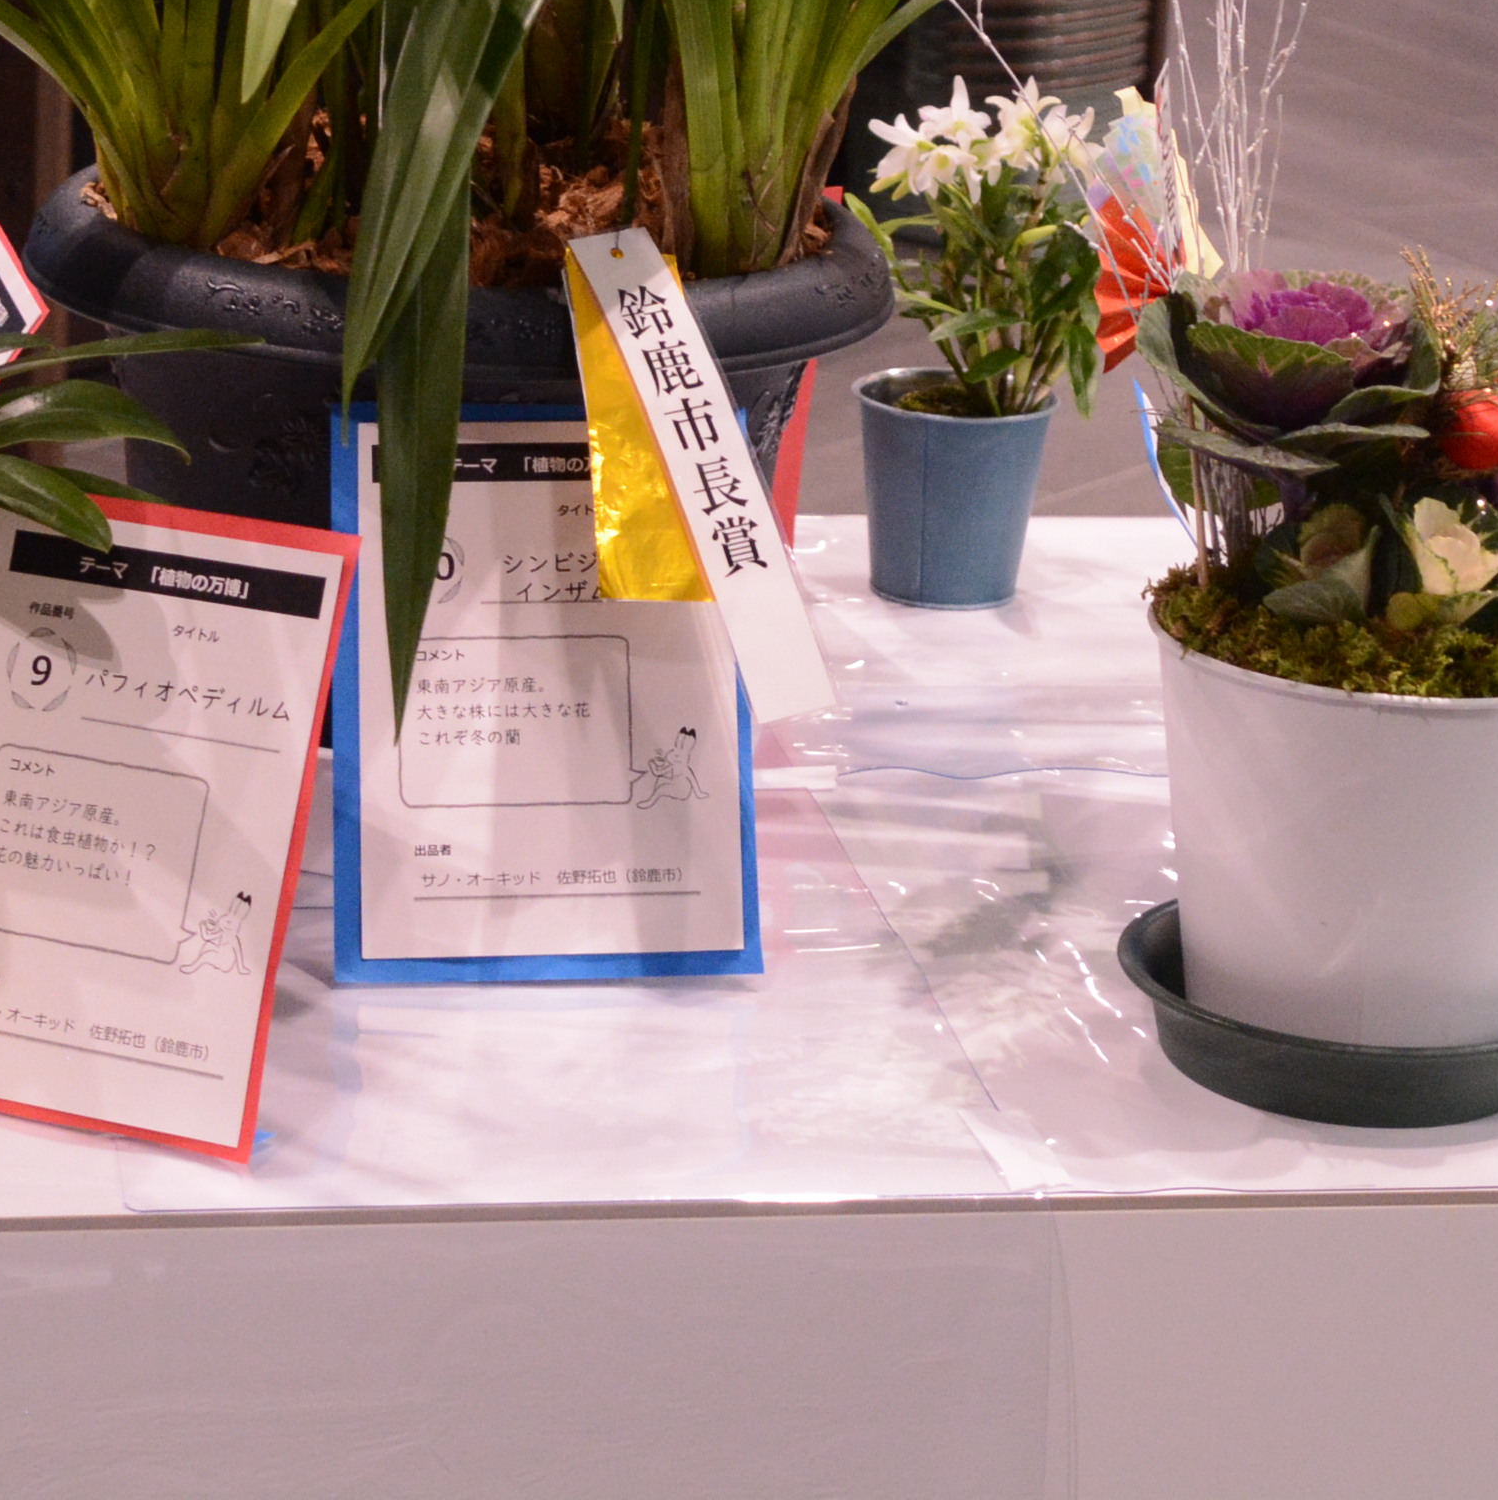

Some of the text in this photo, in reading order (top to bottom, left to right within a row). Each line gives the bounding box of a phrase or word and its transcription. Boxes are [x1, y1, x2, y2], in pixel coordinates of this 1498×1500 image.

[618, 283, 769, 581] 鈴鹿市長賞
[436, 552, 455, 581] 0
[503, 553, 597, 574] シンビジ
[79, 556, 250, 600] テーマ 「植物の万博」
[29, 602, 75, 620] 作品番号
[173, 624, 220, 643] タイトル
[416, 649, 466, 662] コメント
[30, 655, 53, 686] 9
[417, 676, 545, 695] 東南アジア原産。
[85, 669, 291, 722] パフィオペディルム
[416, 701, 591, 721] 大きな株には大きな花
[419, 728, 521, 746] これぞ冬の蘭
[9, 758, 55, 777] コメント
[3, 789, 120, 826] 東南アジア原産。
[414, 843, 452, 857] 出品者
[420, 871, 542, 889] サノ・オーキッド
